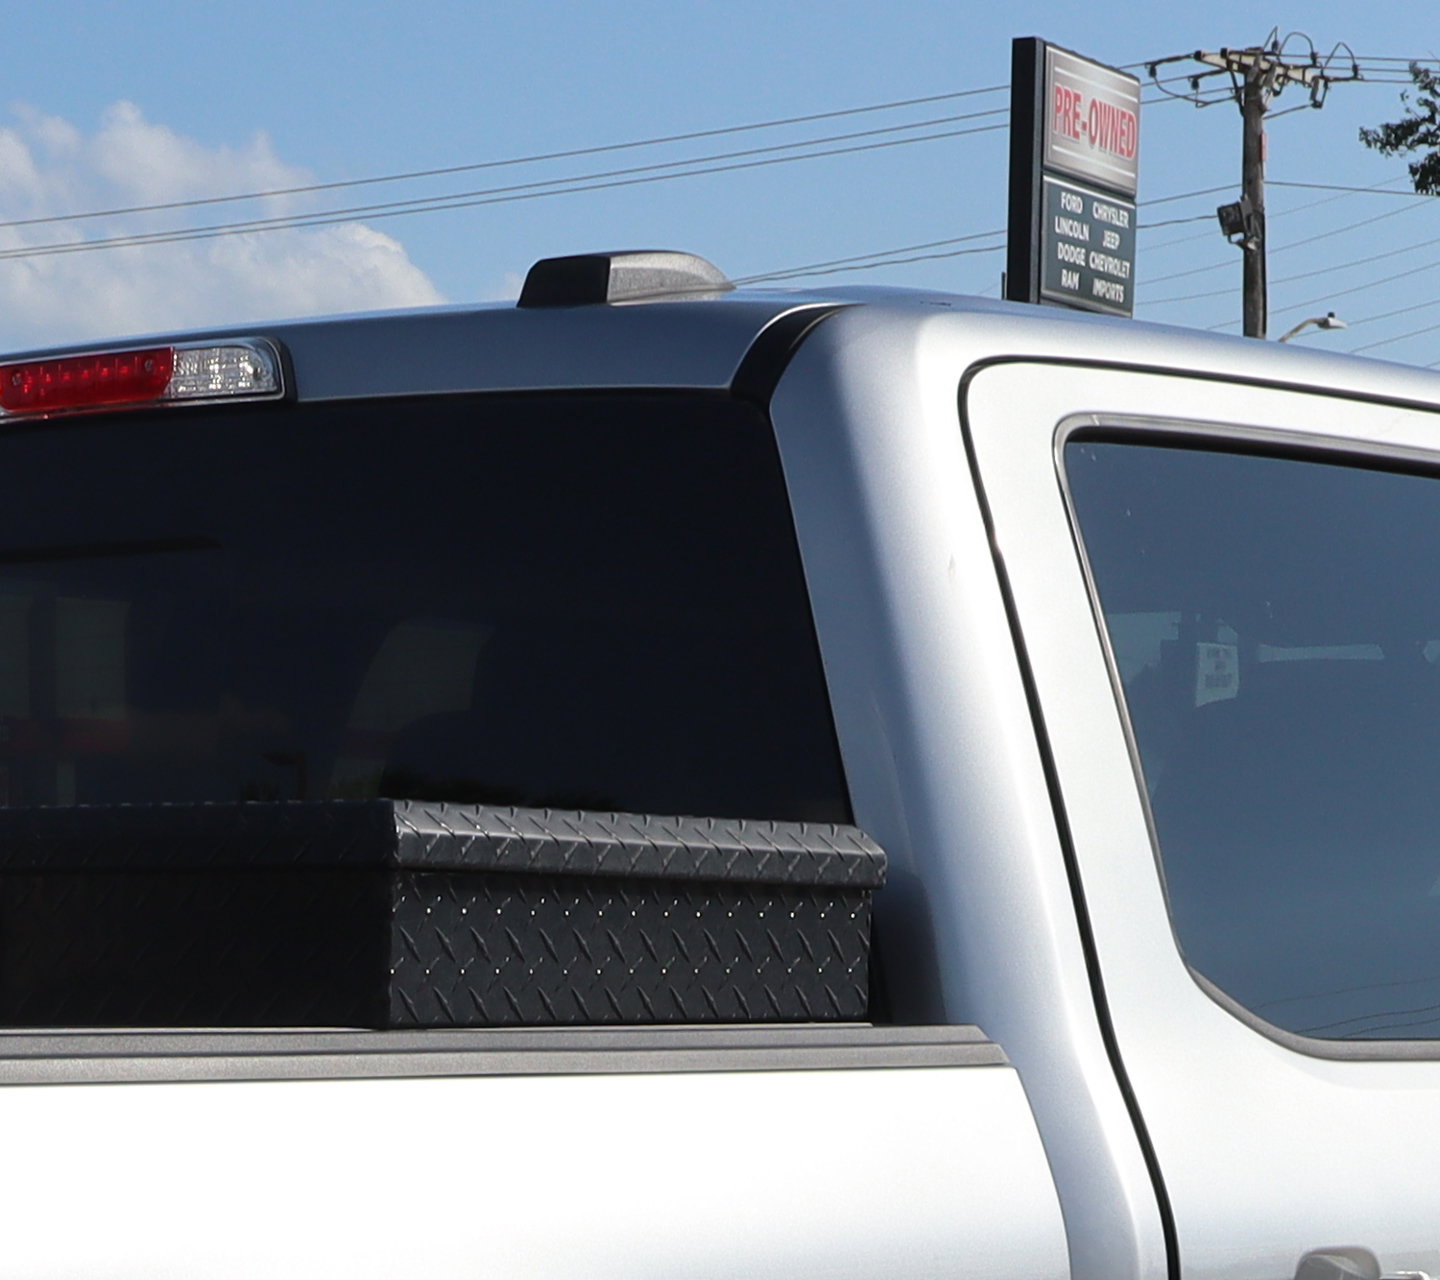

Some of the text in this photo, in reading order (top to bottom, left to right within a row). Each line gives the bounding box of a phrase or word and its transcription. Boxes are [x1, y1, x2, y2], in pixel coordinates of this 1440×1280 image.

[1053, 83, 1137, 160] PRE-OWNED
[1061, 191, 1129, 229] FORD CHRYSLER
[1055, 216, 1120, 250] LINCOLN JEEP
[1057, 241, 1130, 278] DODGE CHEVROLET
[1061, 268, 1124, 303] RAM IMPORTS
